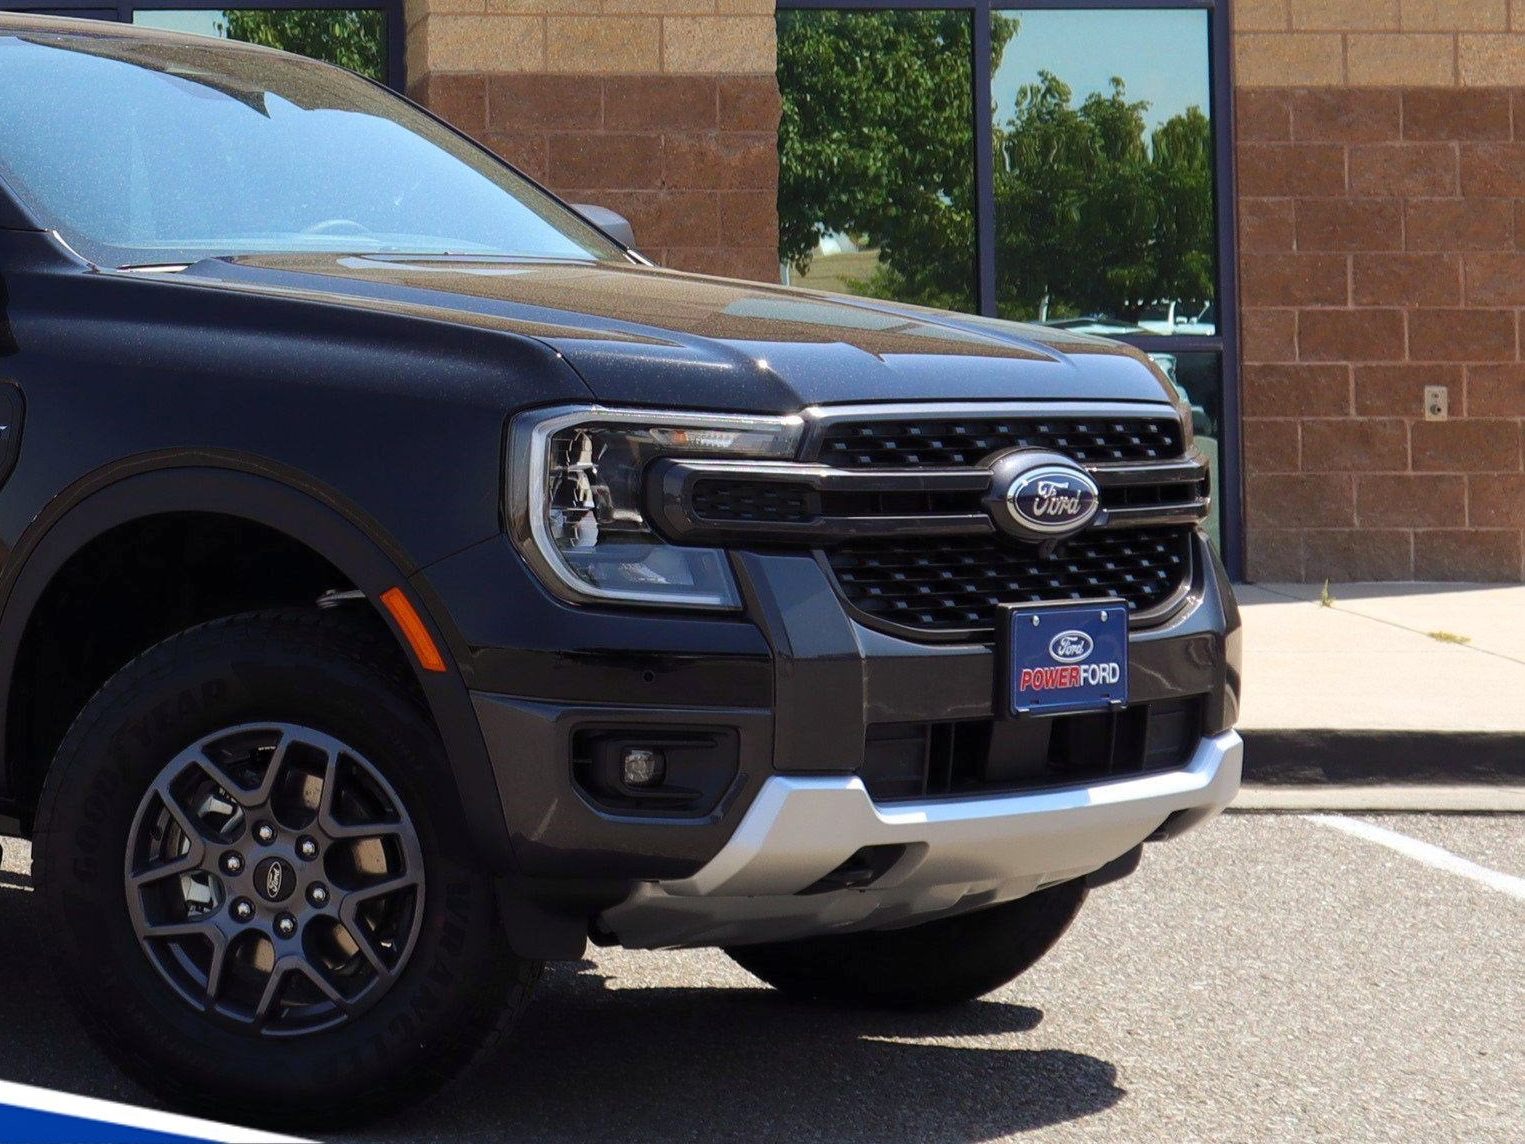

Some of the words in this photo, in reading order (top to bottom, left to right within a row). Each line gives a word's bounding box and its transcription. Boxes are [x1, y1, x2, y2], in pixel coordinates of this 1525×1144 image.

[1033, 480, 1082, 516] Ford
[1058, 636, 1084, 656] Ford
[1020, 662, 1120, 692] POWERFORD
